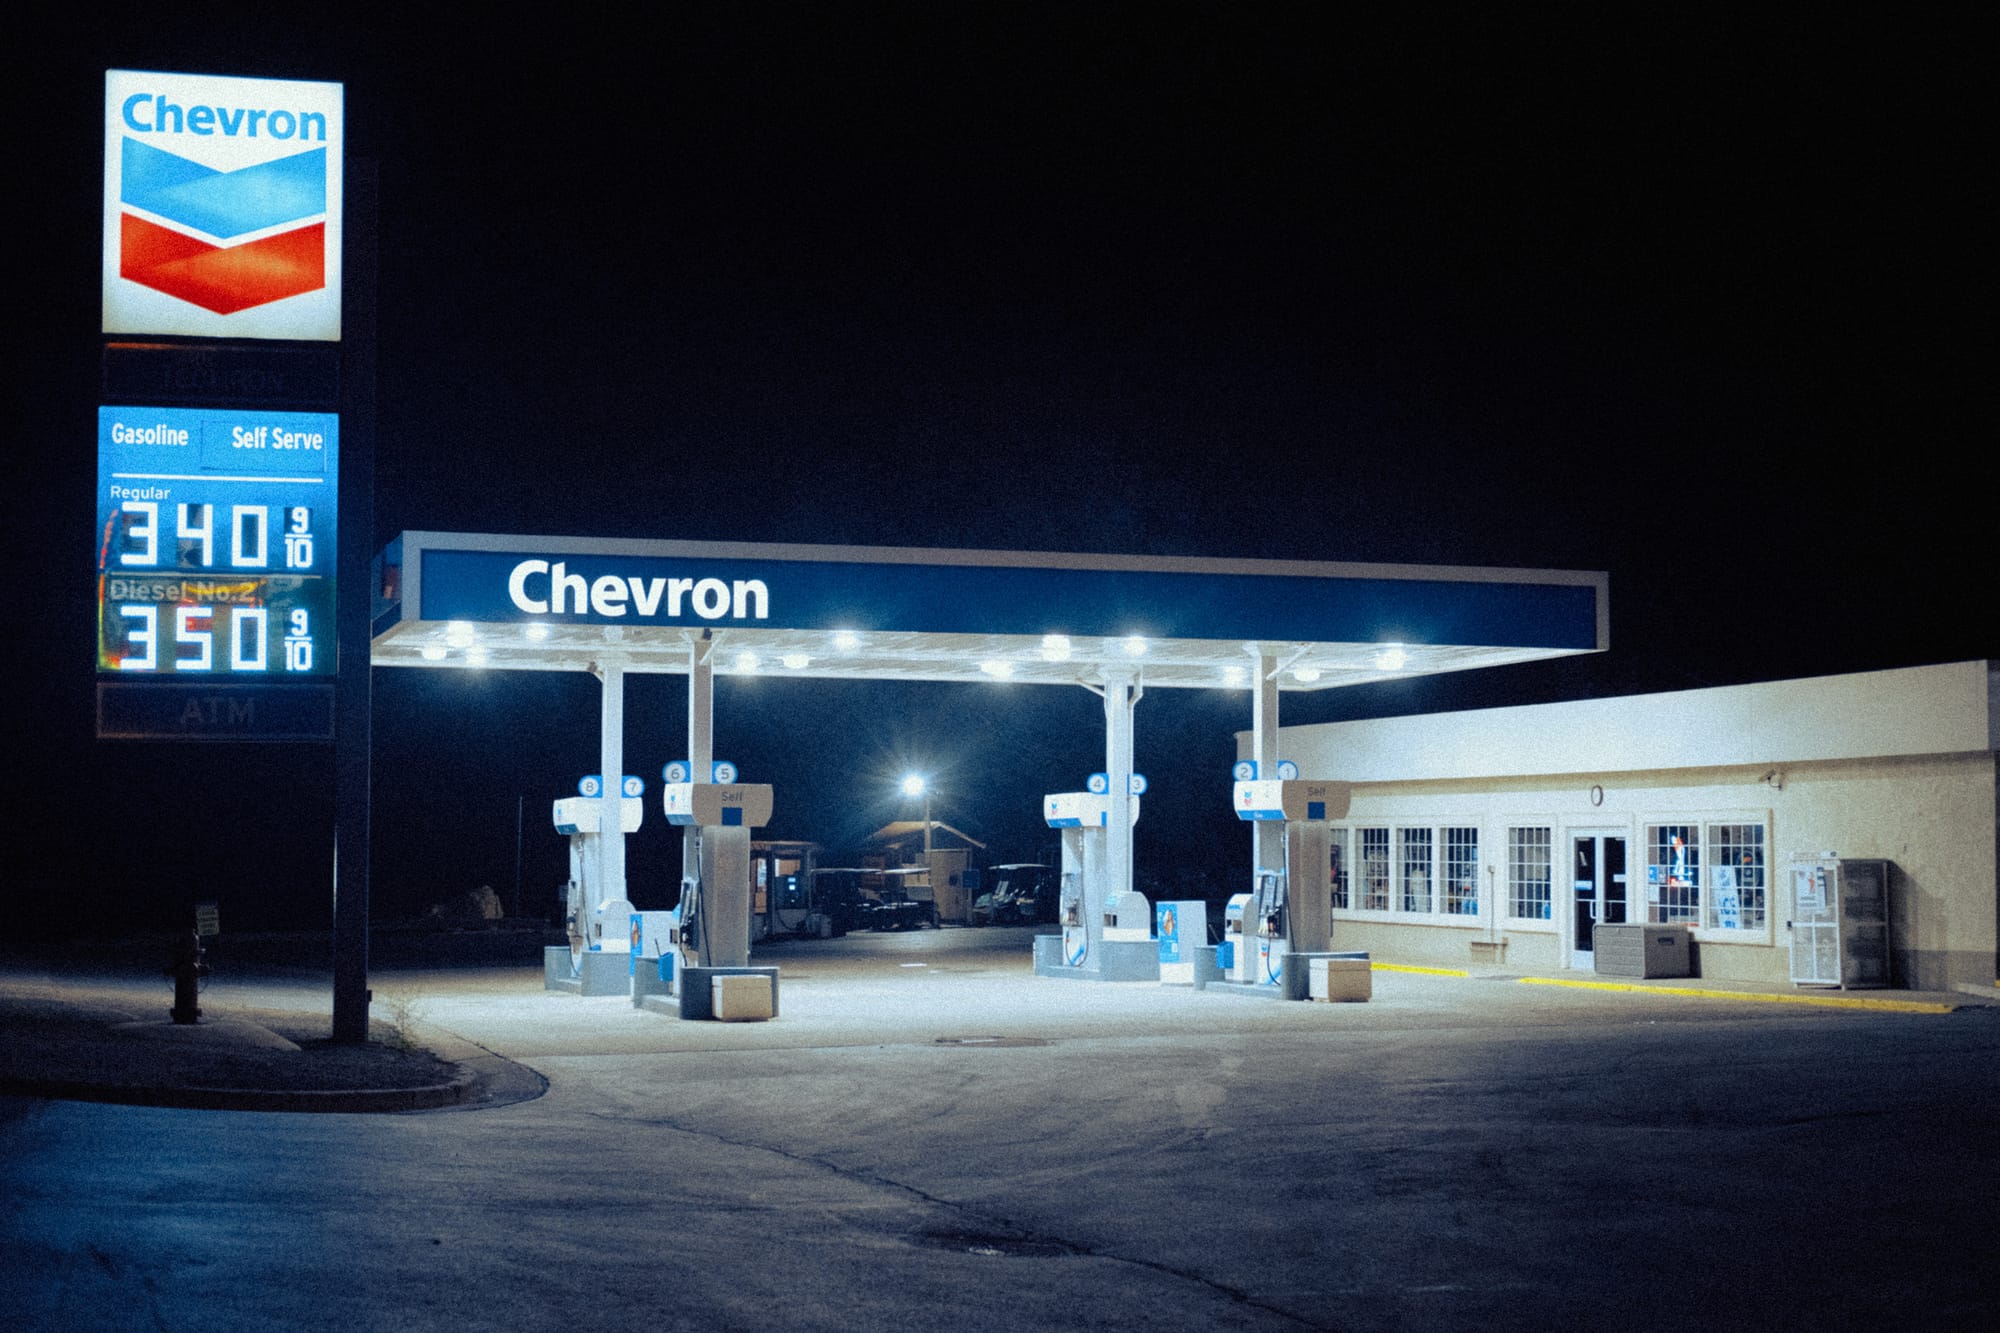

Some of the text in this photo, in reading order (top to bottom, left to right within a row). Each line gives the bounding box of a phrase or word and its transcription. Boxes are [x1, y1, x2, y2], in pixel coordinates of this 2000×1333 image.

[122, 93, 327, 141] Chevron
[111, 422, 189, 446] Gasoline
[232, 426, 323, 450] Self Serve
[110, 485, 170, 502] Regular
[120, 502, 313, 568] 340 9 10
[110, 579, 188, 601] Diesel
[508, 559, 769, 619] Chevron
[119, 605, 313, 671] 350 9 10
[178, 695, 256, 725] ATM
